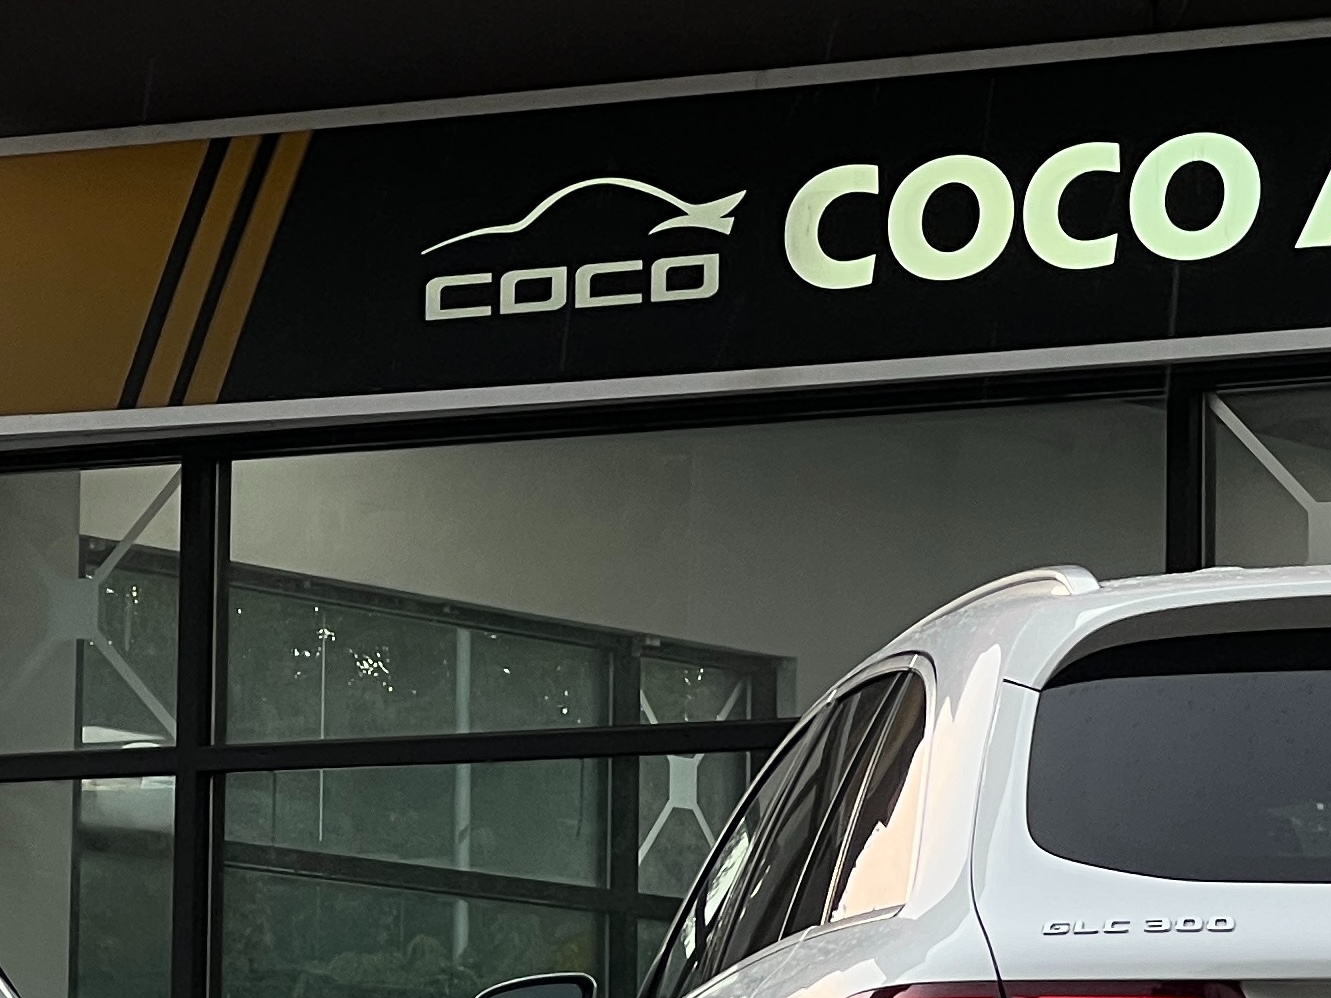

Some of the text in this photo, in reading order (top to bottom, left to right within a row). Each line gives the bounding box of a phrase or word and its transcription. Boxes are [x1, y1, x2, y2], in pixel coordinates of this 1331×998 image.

[784, 131, 1262, 290] COCO
[425, 253, 720, 321] COCO
[1041, 916, 1237, 936] GLC 300
